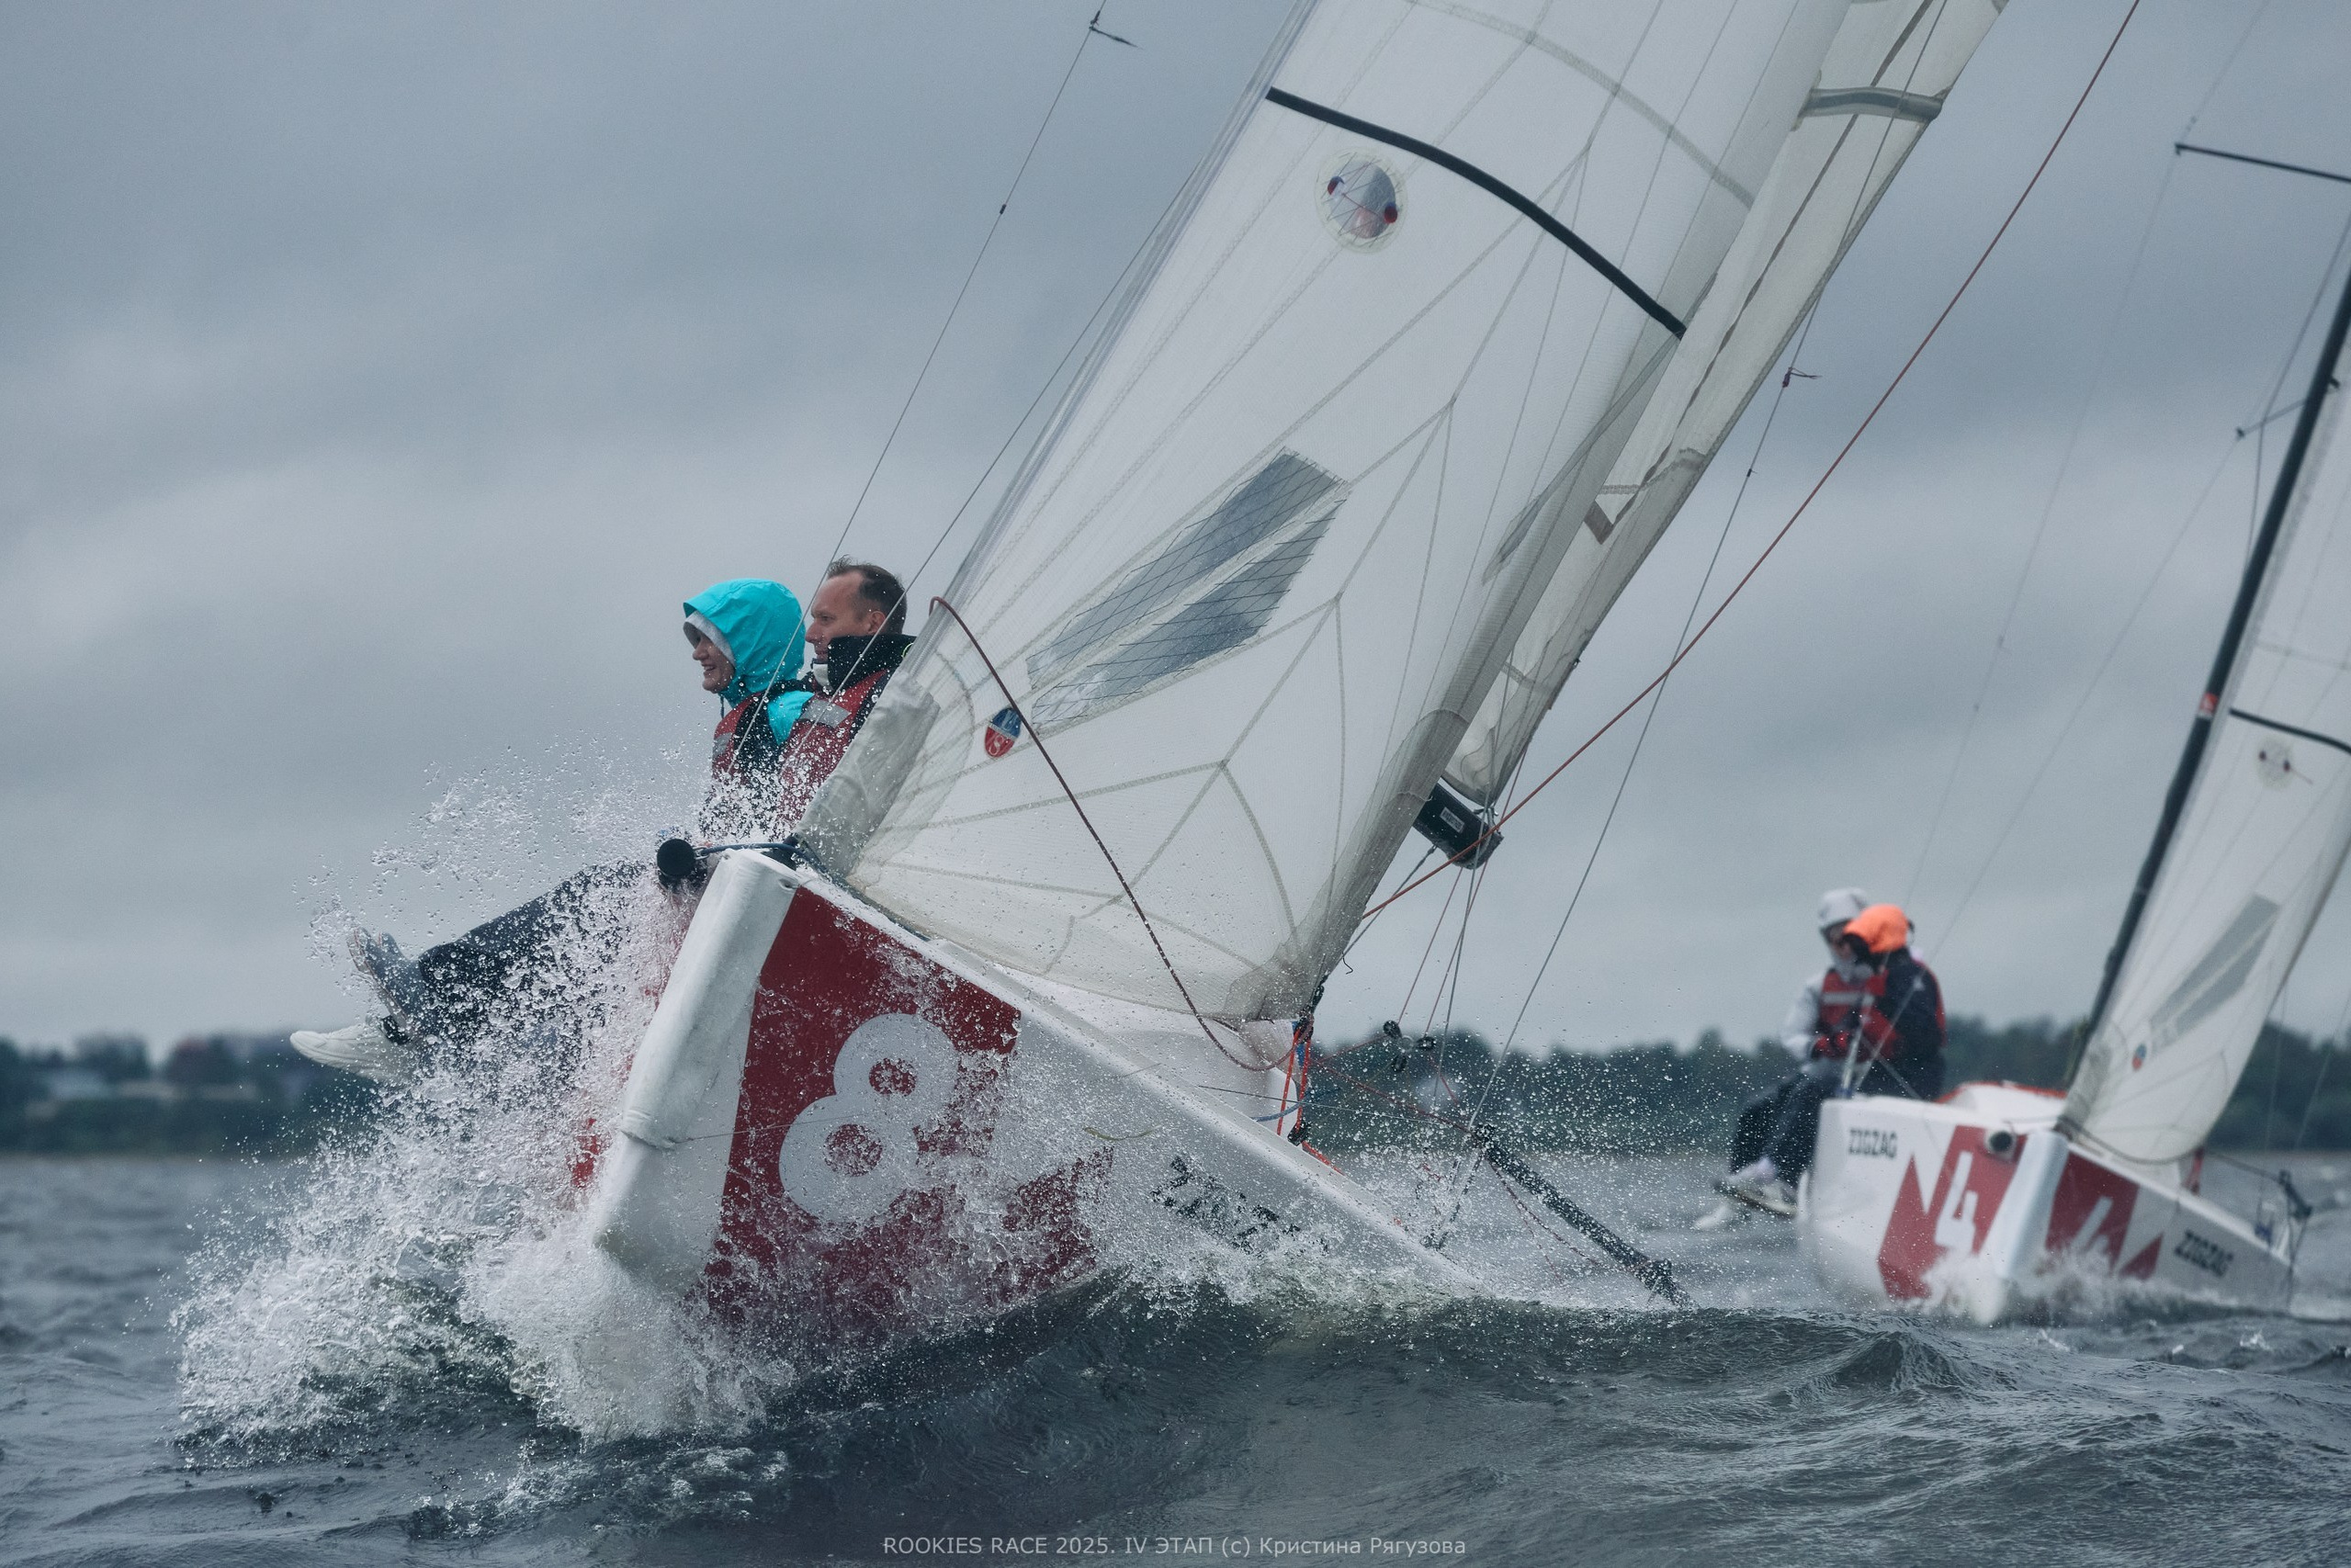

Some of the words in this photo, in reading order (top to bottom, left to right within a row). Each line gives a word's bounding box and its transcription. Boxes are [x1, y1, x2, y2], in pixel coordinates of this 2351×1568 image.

[779, 1013, 960, 1225] 8
[1848, 1127, 1897, 1159] ZIGZAG
[2174, 1230, 2233, 1278] ZIGZAG
